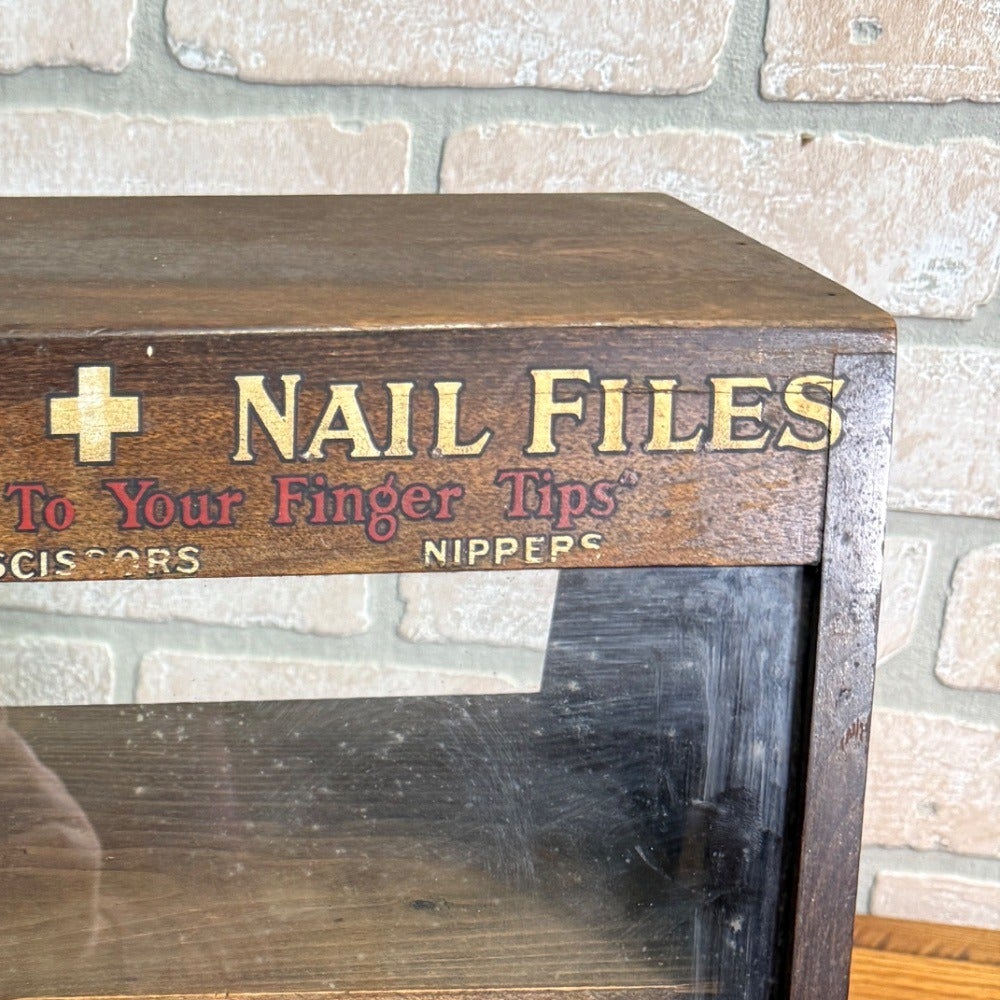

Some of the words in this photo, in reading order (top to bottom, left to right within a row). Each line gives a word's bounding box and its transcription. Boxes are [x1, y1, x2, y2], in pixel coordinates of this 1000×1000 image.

[231, 373, 494, 463] NAIL
[524, 367, 850, 455] FILES
[7, 483, 76, 532] To
[106, 480, 244, 529] Your
[274, 474, 466, 543] Finger
[424, 533, 603, 566] NIPPERS
